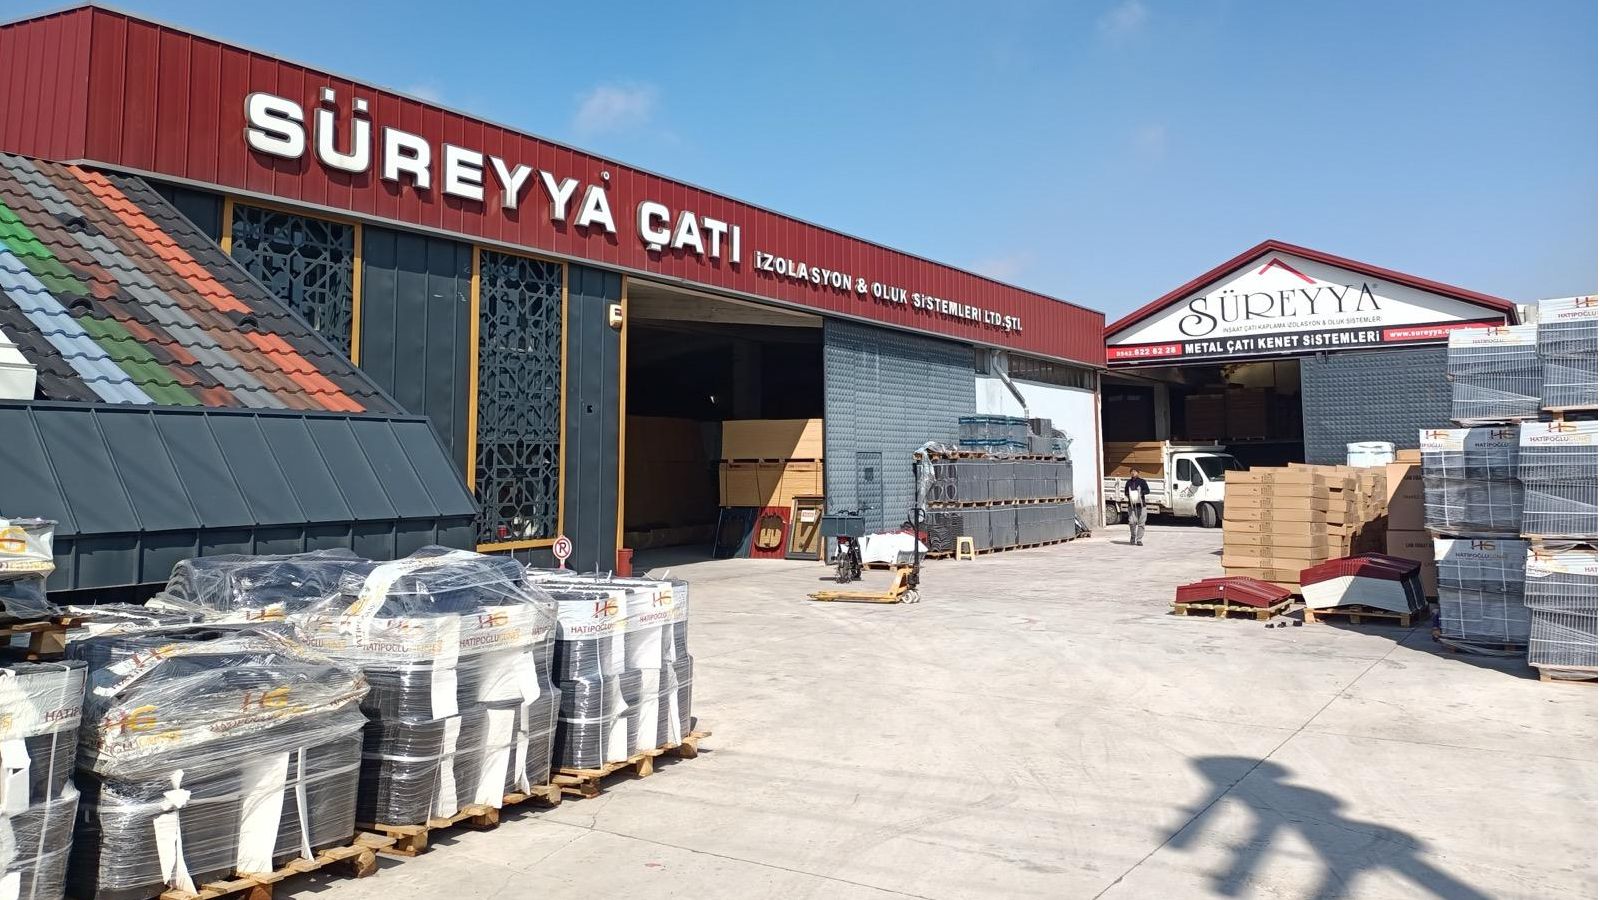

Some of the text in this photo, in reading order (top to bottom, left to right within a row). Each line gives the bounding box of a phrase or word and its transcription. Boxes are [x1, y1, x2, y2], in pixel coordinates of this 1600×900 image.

[245, 86, 741, 264] SÜREYYA ÇATI
[856, 277, 868, 294] &
[872, 281, 907, 304] OLUK
[1178, 282, 1382, 337] SÜREYYA
[1258, 322, 1286, 330] KAPLAMA
[1184, 341, 1223, 354] METAL
[1226, 339, 1254, 354] ÇATI
[1257, 335, 1299, 349] KENET
